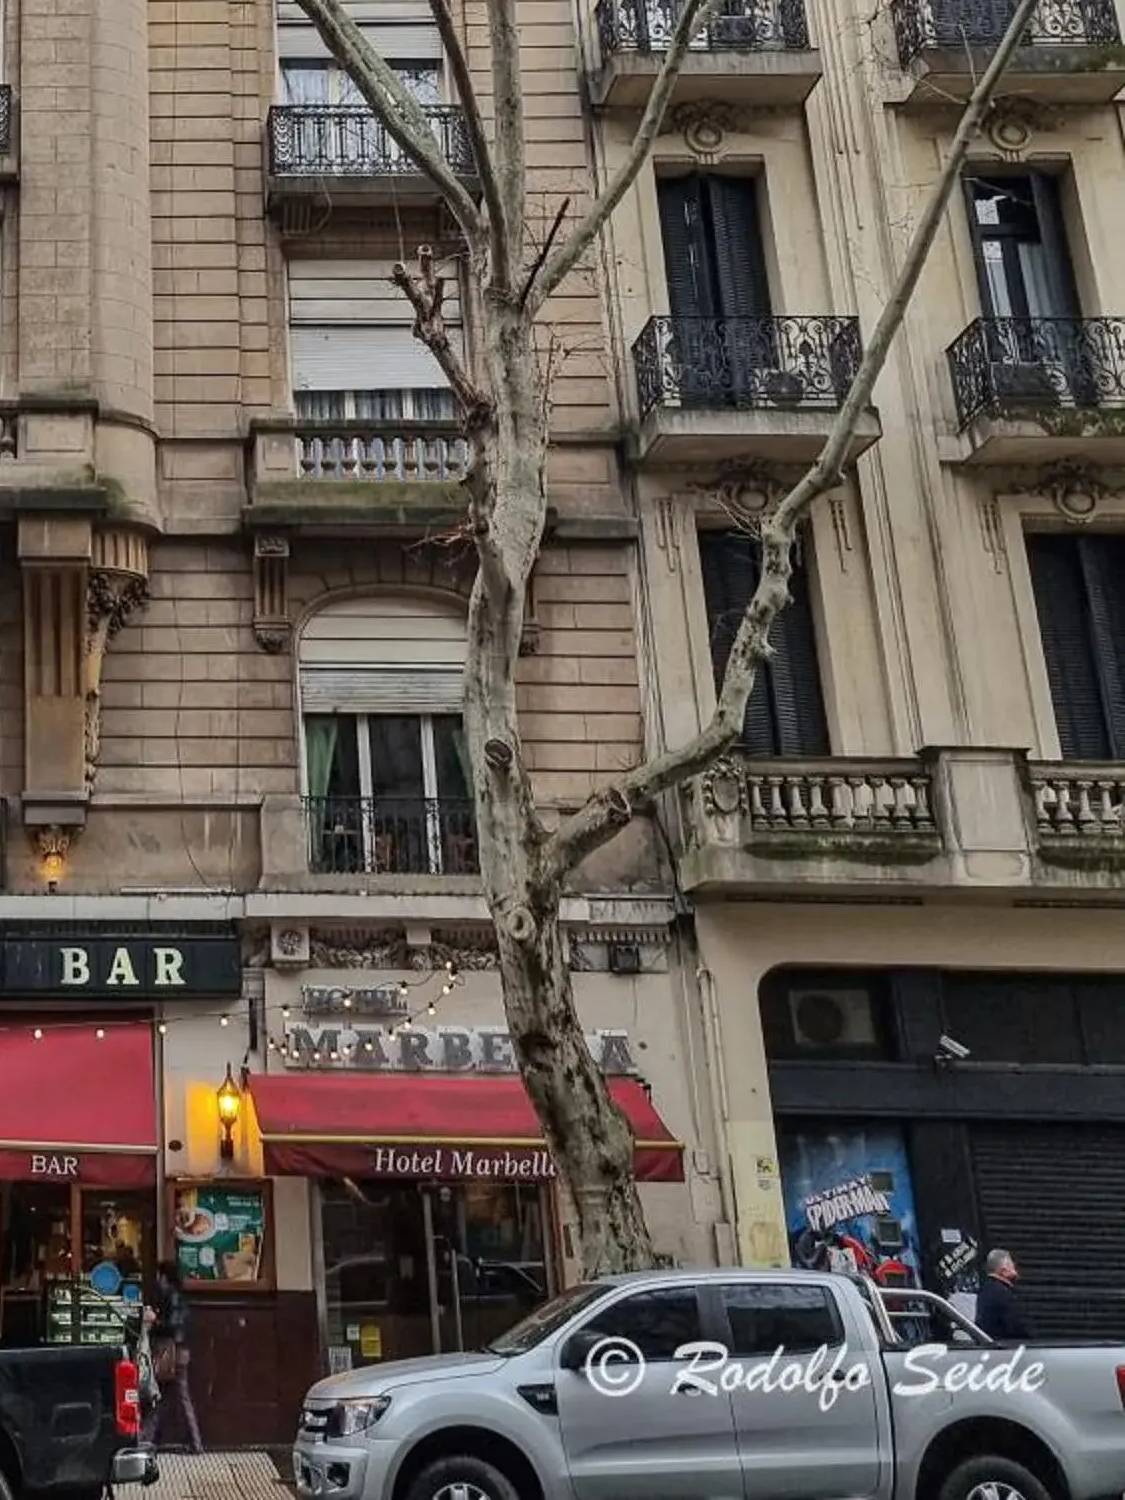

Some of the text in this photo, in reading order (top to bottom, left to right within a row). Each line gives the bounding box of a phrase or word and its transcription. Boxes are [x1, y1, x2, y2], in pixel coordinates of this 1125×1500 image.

[60, 947, 187, 985] BAR
[288, 1025, 638, 1075] MARBEA
[31, 1155, 78, 1176] BAR
[375, 1148, 442, 1173] Hotel
